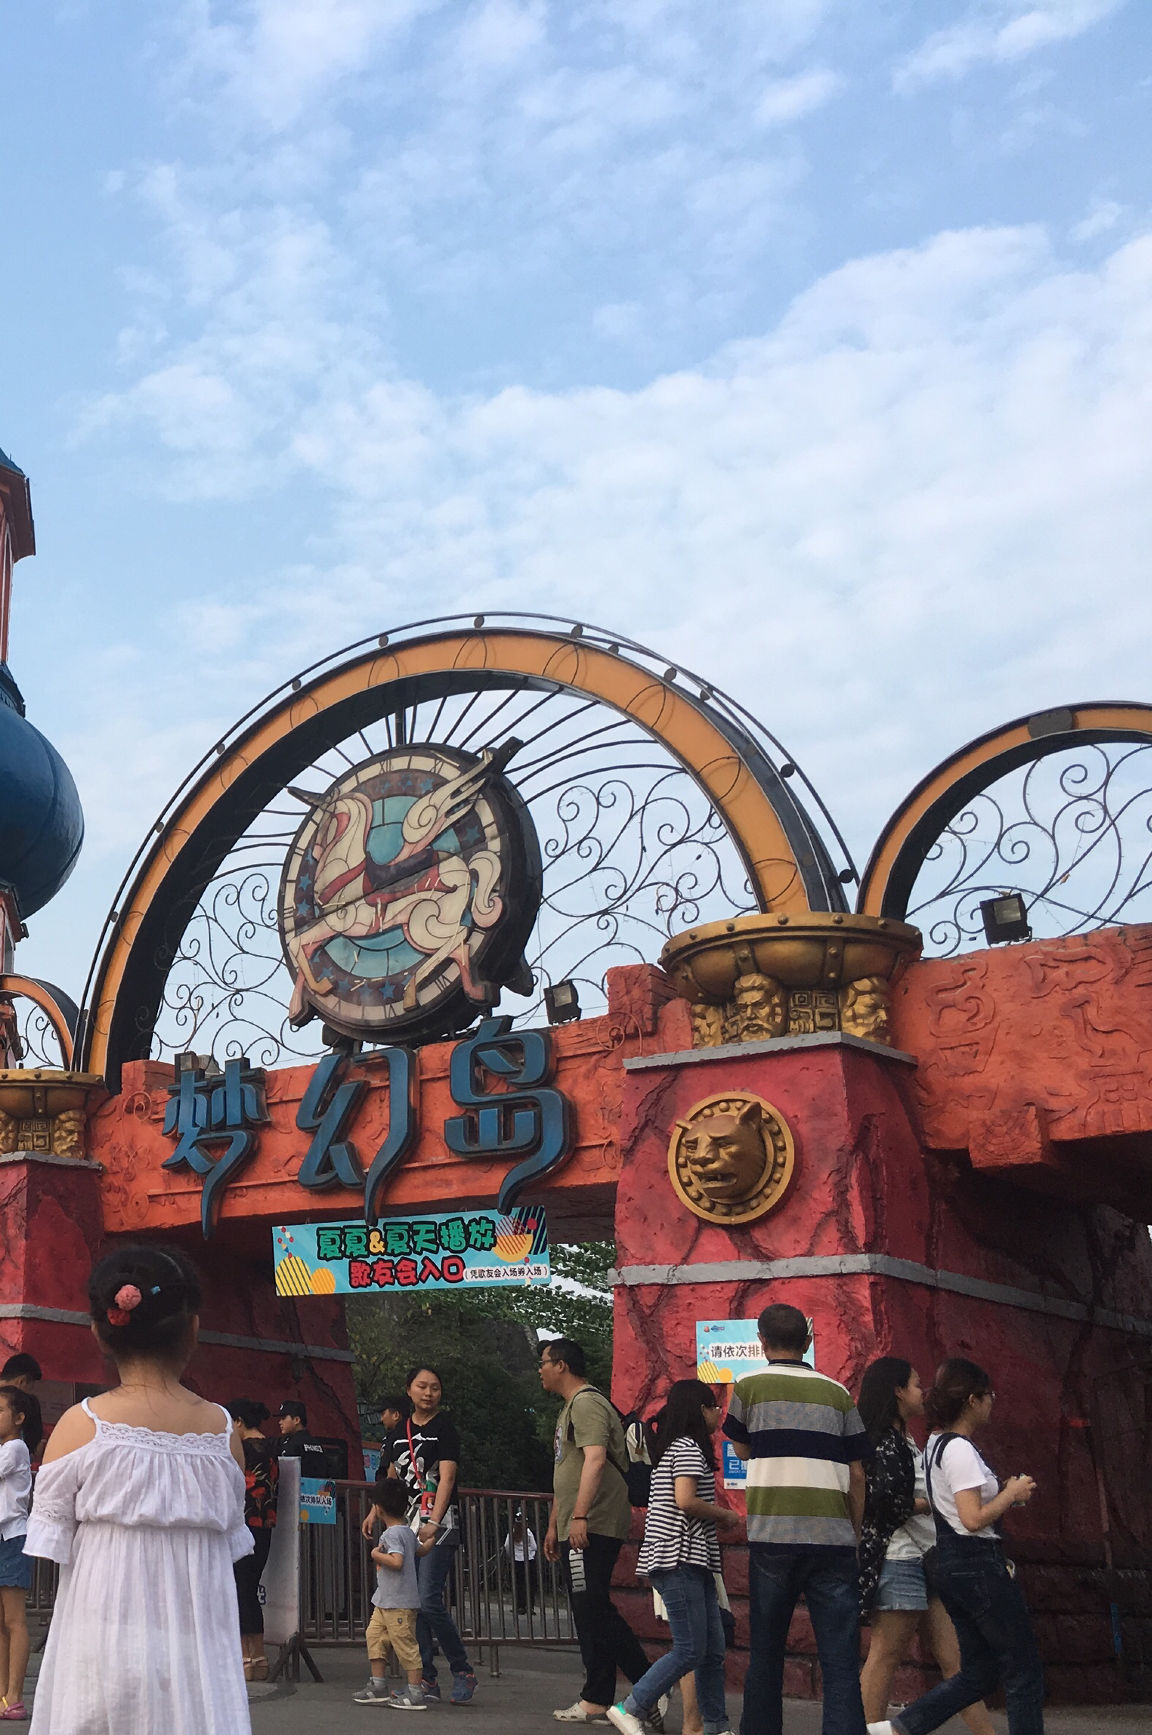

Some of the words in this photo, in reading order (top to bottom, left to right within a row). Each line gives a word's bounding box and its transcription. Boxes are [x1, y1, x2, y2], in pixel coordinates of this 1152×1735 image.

[161, 1015, 578, 1240] 梦幻岛
[350, 1257, 465, 1288] 歌友会入口
[711, 1345, 765, 1358] 请依次排
